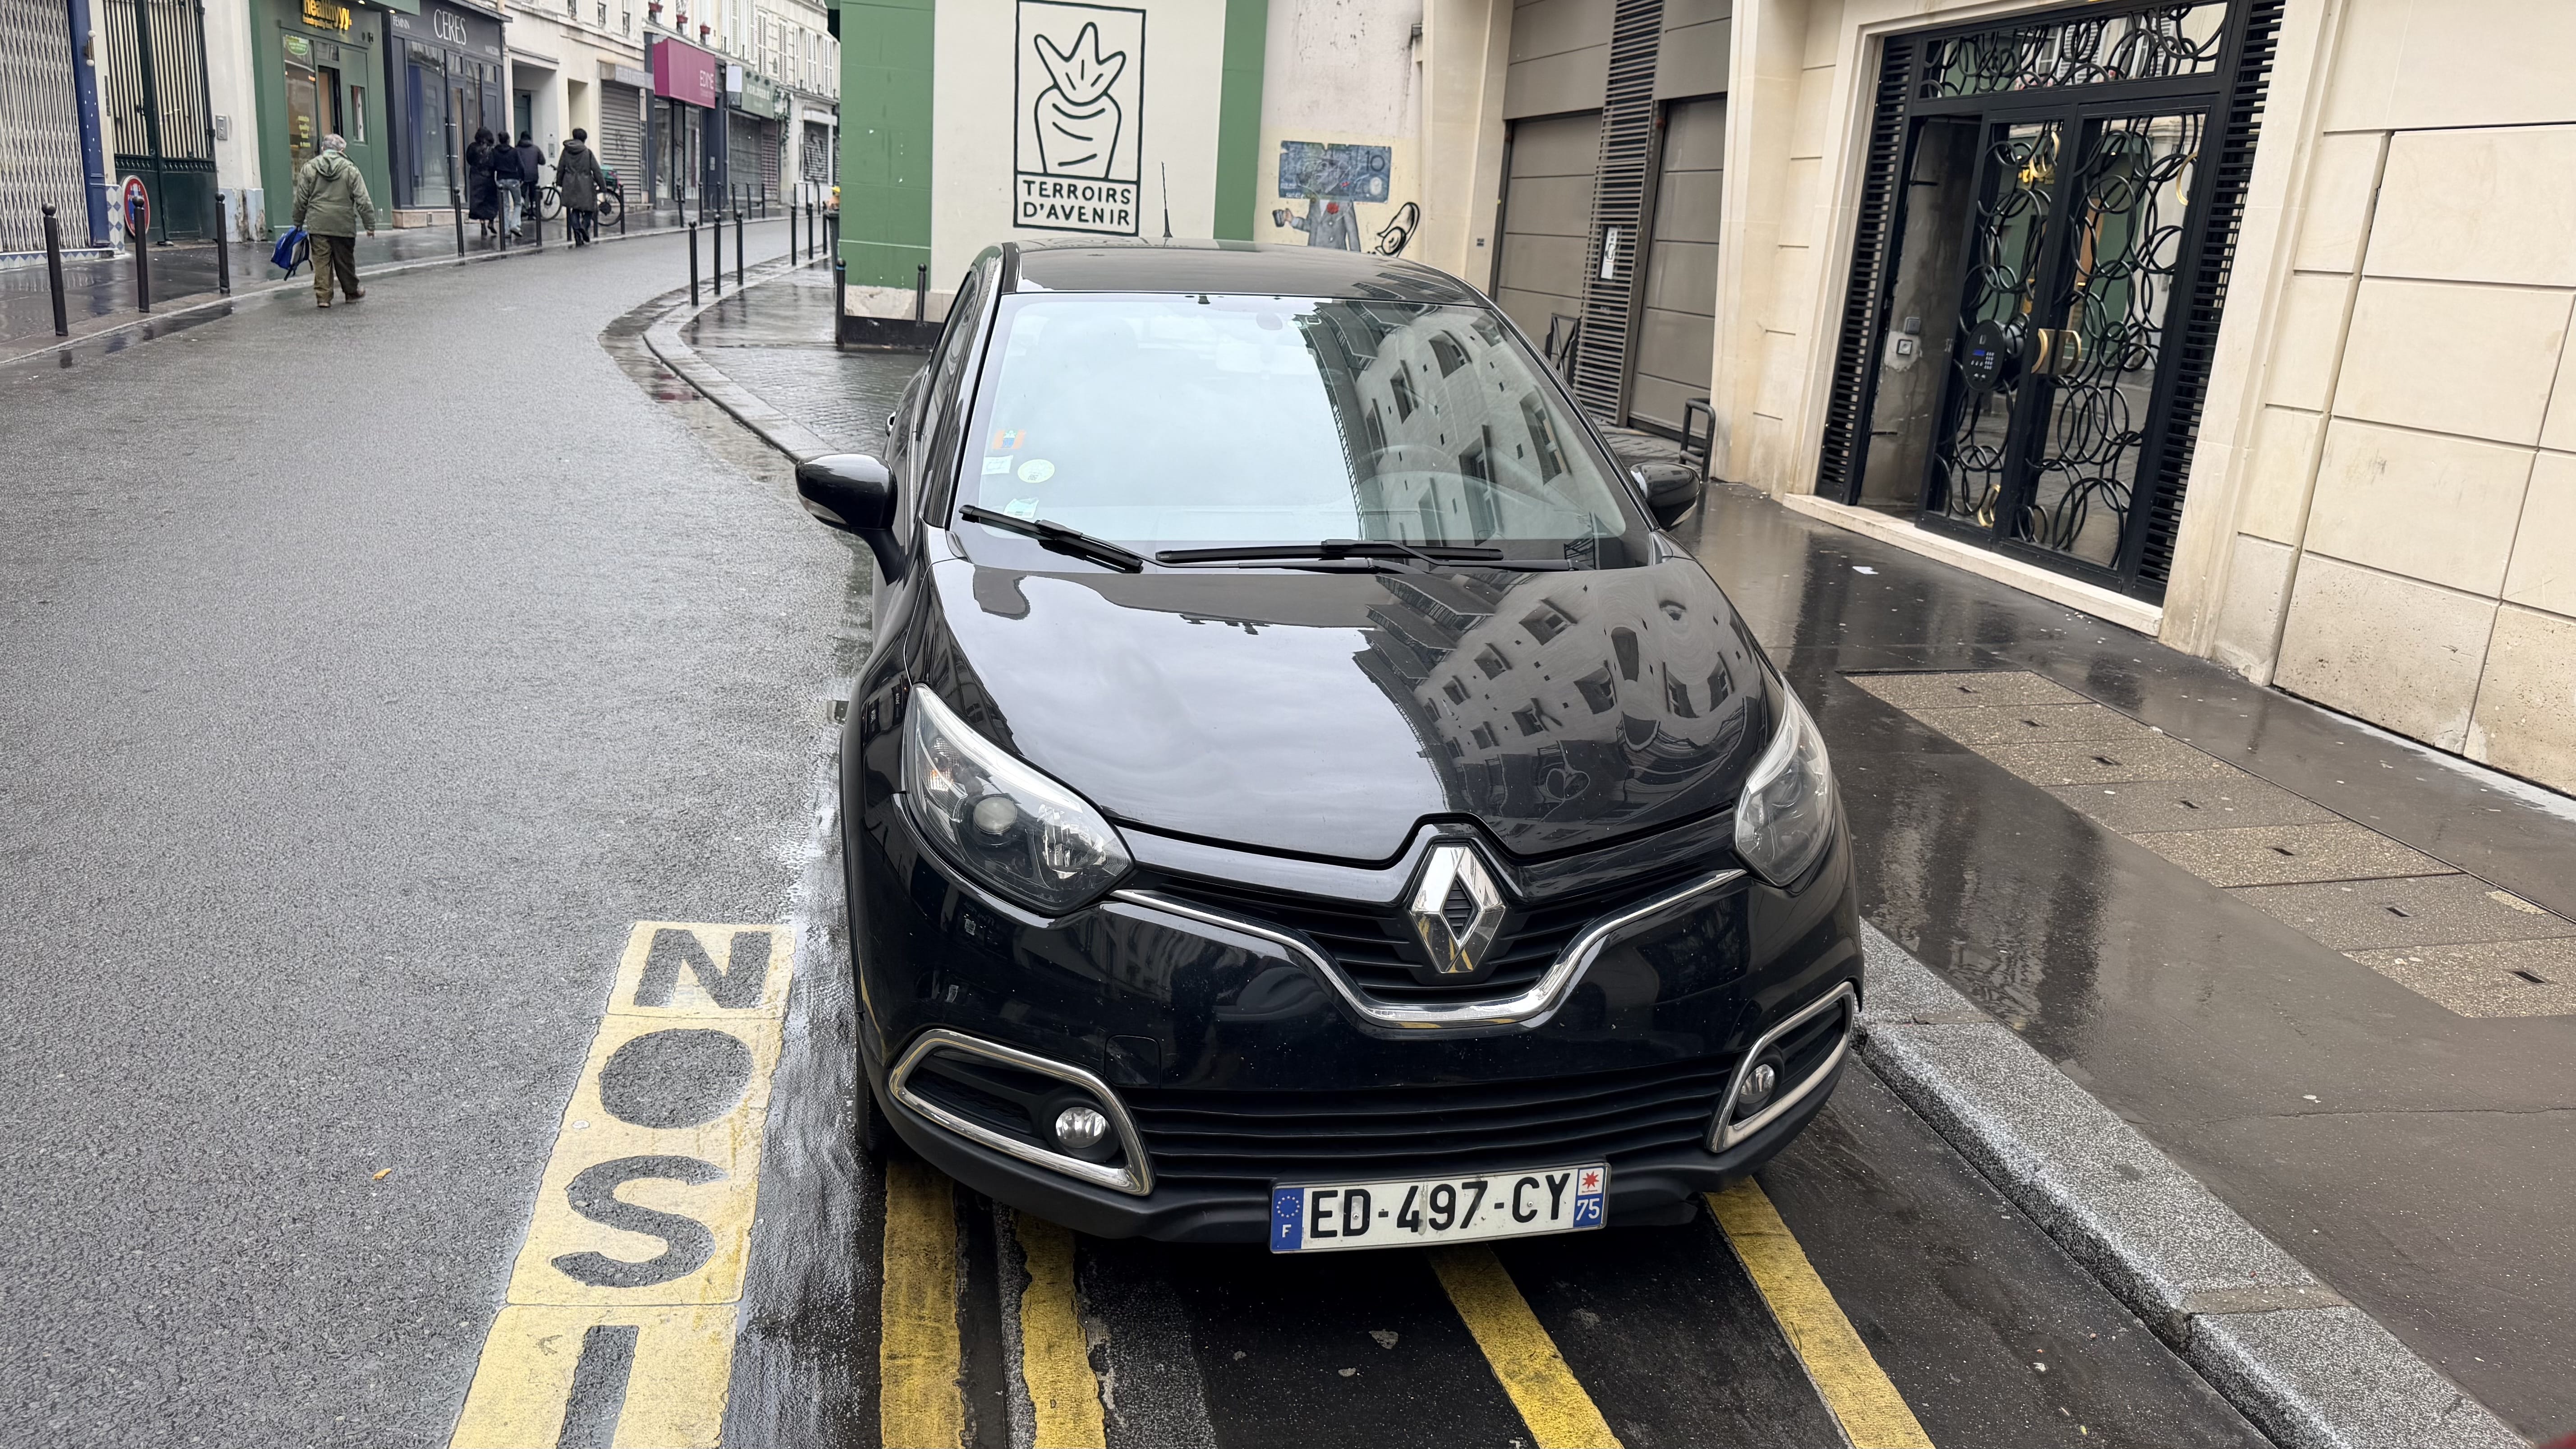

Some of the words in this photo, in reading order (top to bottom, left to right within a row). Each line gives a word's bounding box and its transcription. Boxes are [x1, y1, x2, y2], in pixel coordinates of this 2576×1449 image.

[433, 9, 467, 45] CERES
[1365, 151, 1385, 172] 10
[1022, 180, 1131, 205] TERROIRS
[1023, 202, 1130, 226] D'AVENIR
[1310, 1173, 1570, 1239] ED-497-CY
[1576, 1197, 1600, 1220] 75
[1282, 1224, 1292, 1238] F
